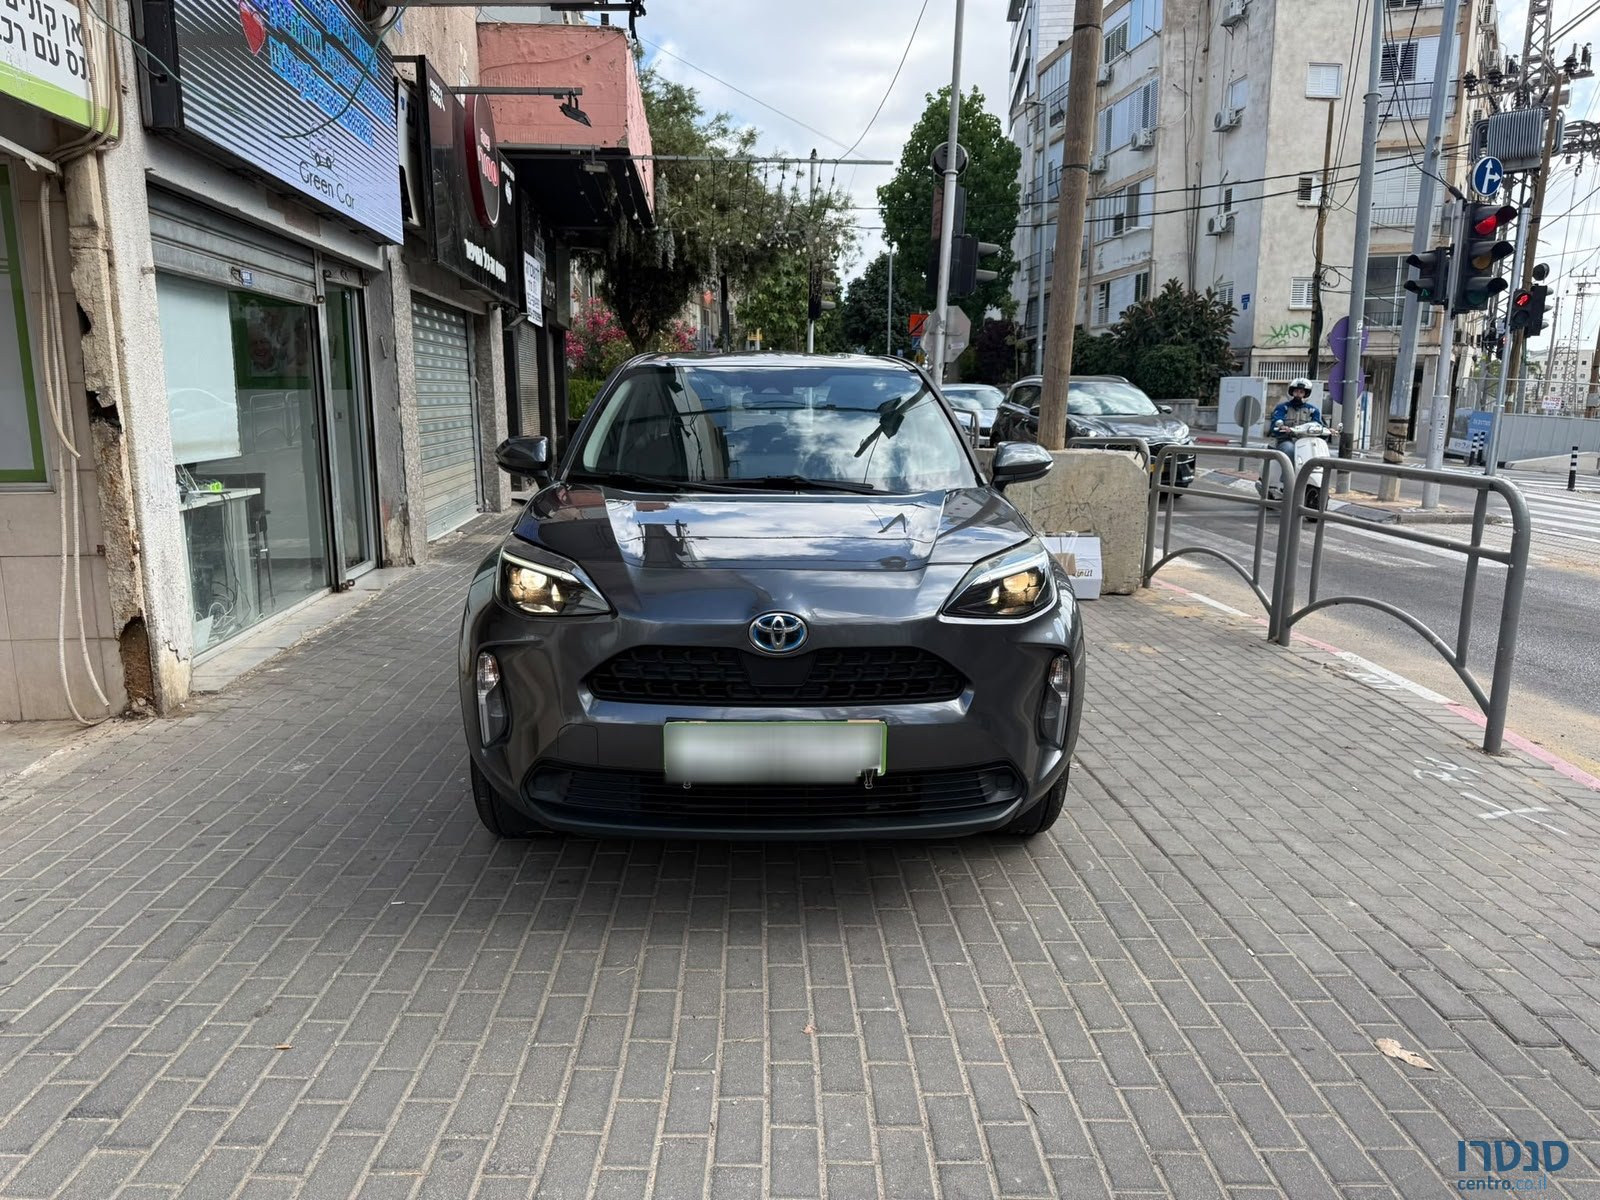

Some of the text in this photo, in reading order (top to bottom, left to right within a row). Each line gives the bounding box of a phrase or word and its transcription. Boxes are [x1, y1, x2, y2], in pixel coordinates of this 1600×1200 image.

[0, 16, 27, 52] רכ
[33, 31, 60, 67] עם
[62, 14, 88, 48] אן
[299, 160, 355, 210] Green Car
